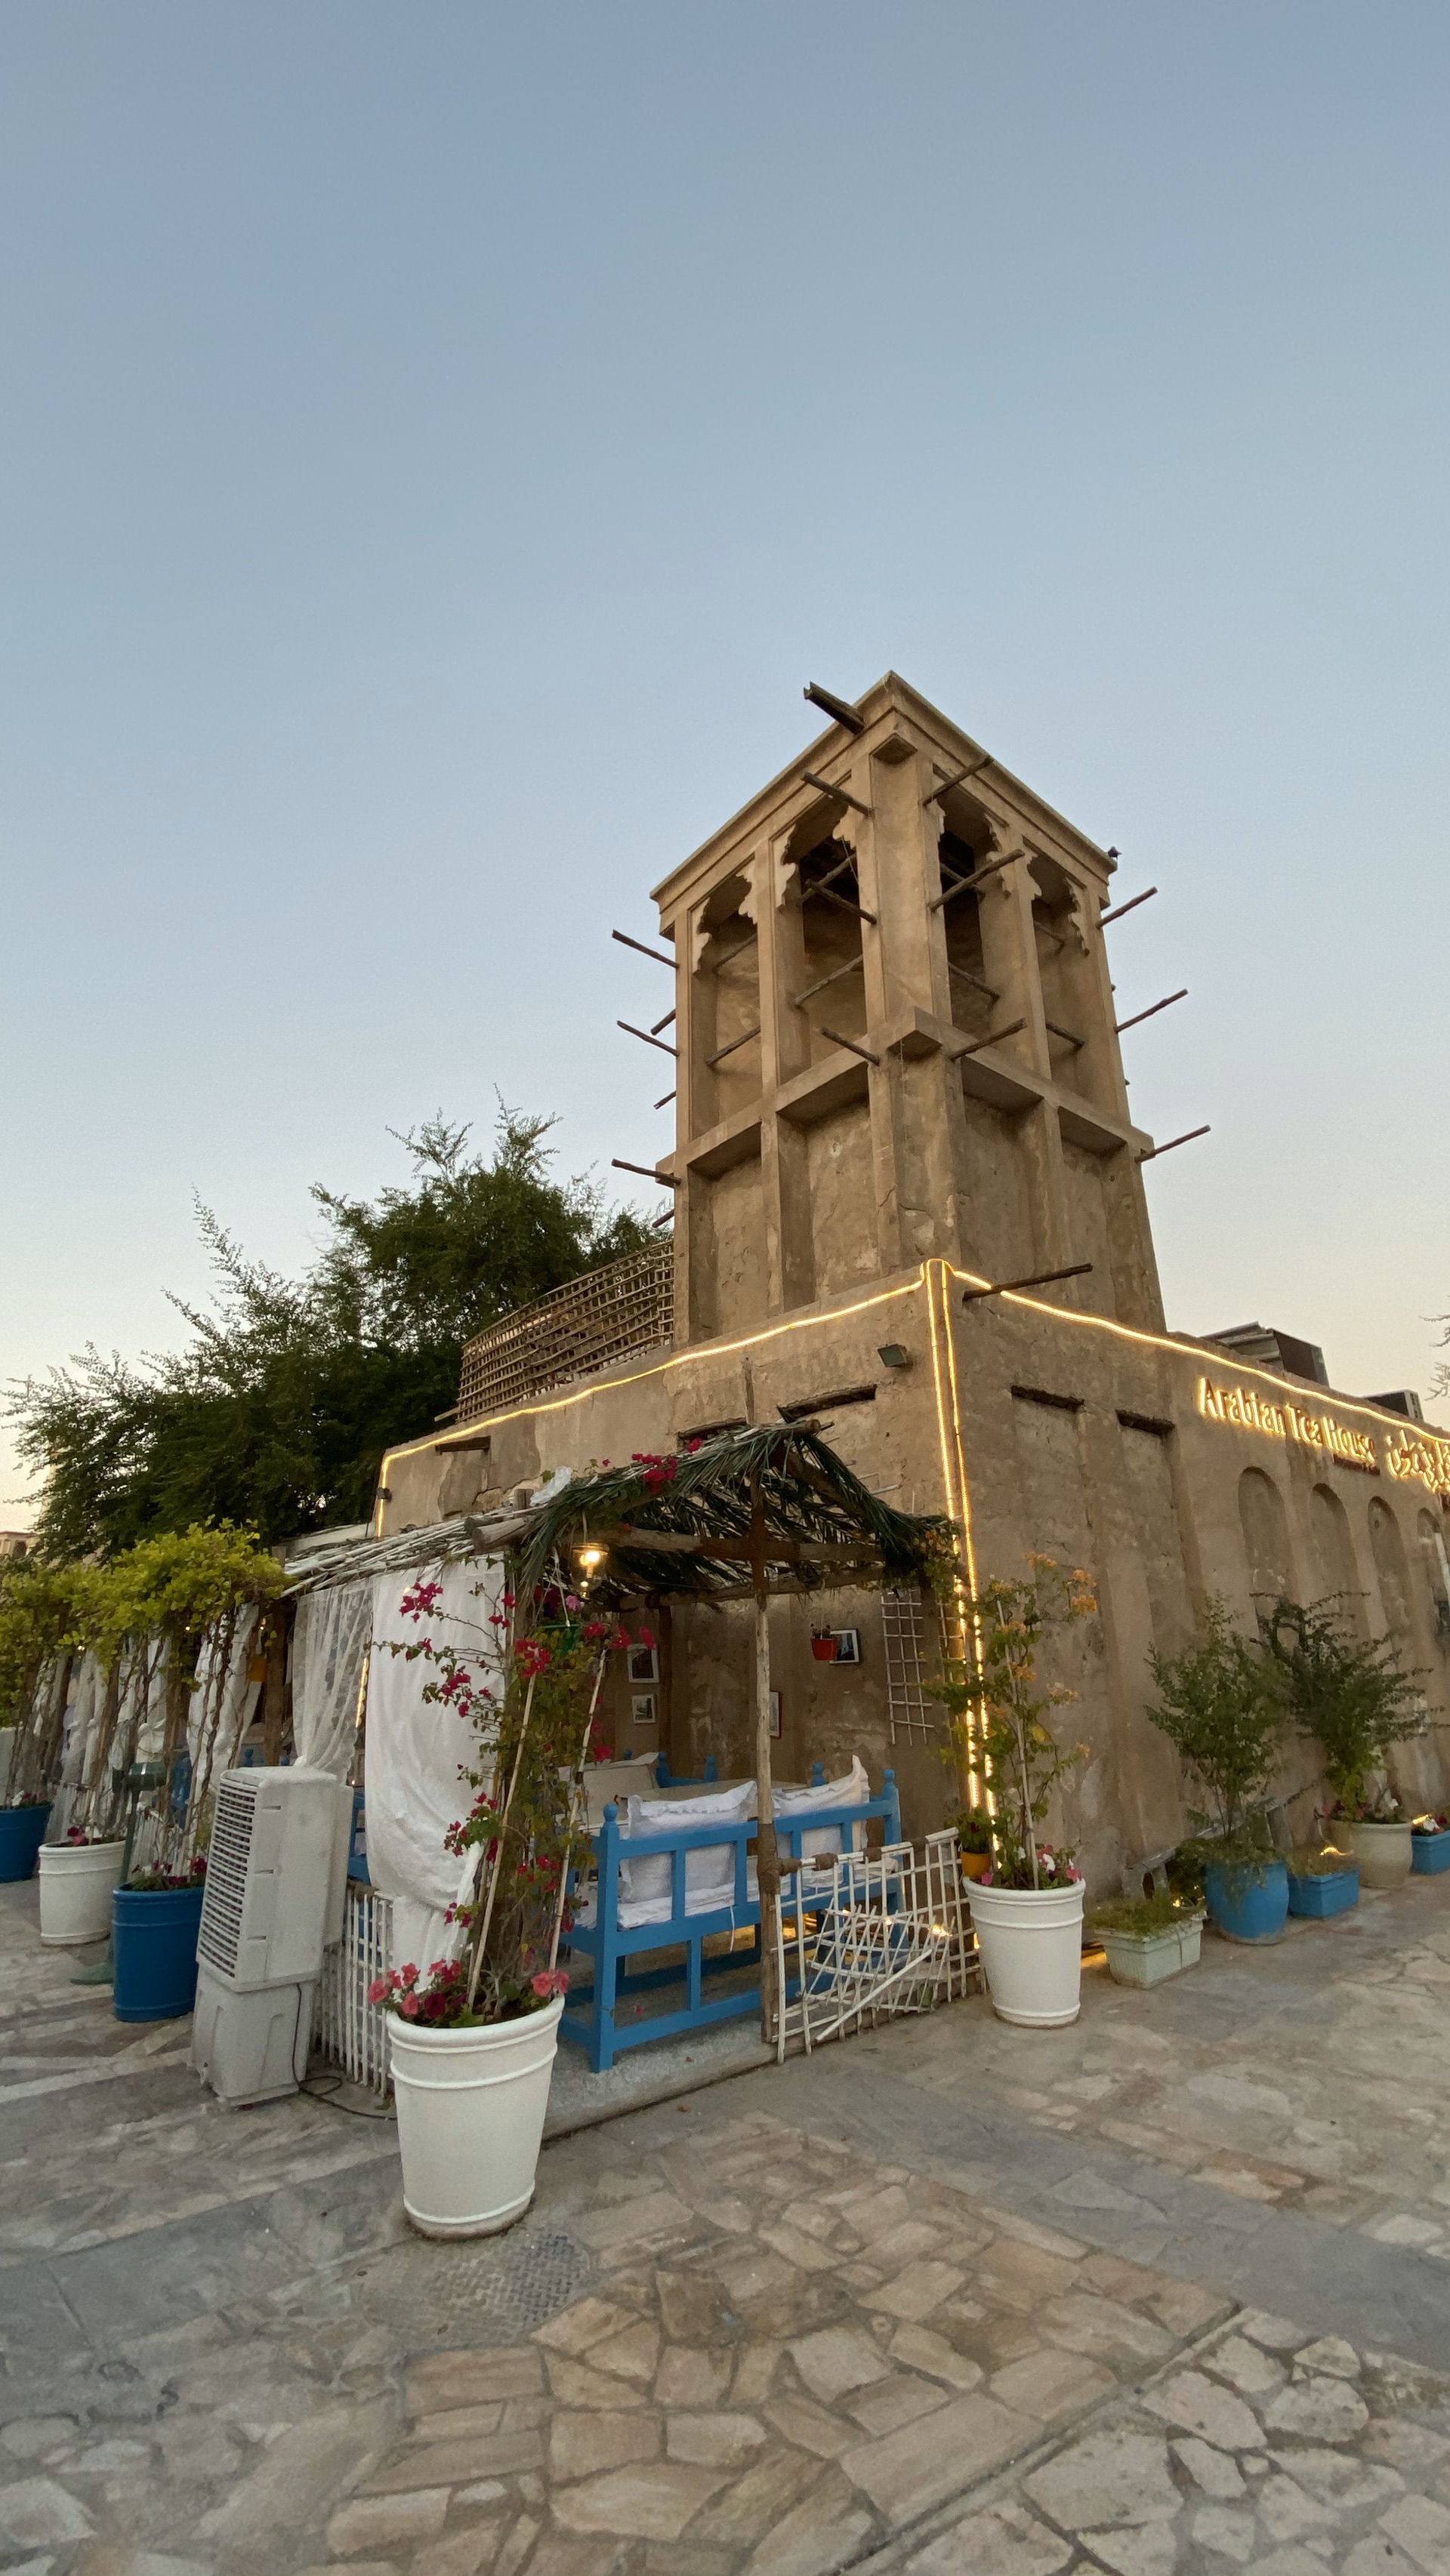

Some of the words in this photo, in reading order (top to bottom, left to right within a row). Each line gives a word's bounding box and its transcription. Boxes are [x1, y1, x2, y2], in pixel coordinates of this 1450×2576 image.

[1199, 1377, 1286, 1435] Arabian
[1285, 1404, 1322, 1447] Tea
[1322, 1416, 1376, 1462] House
